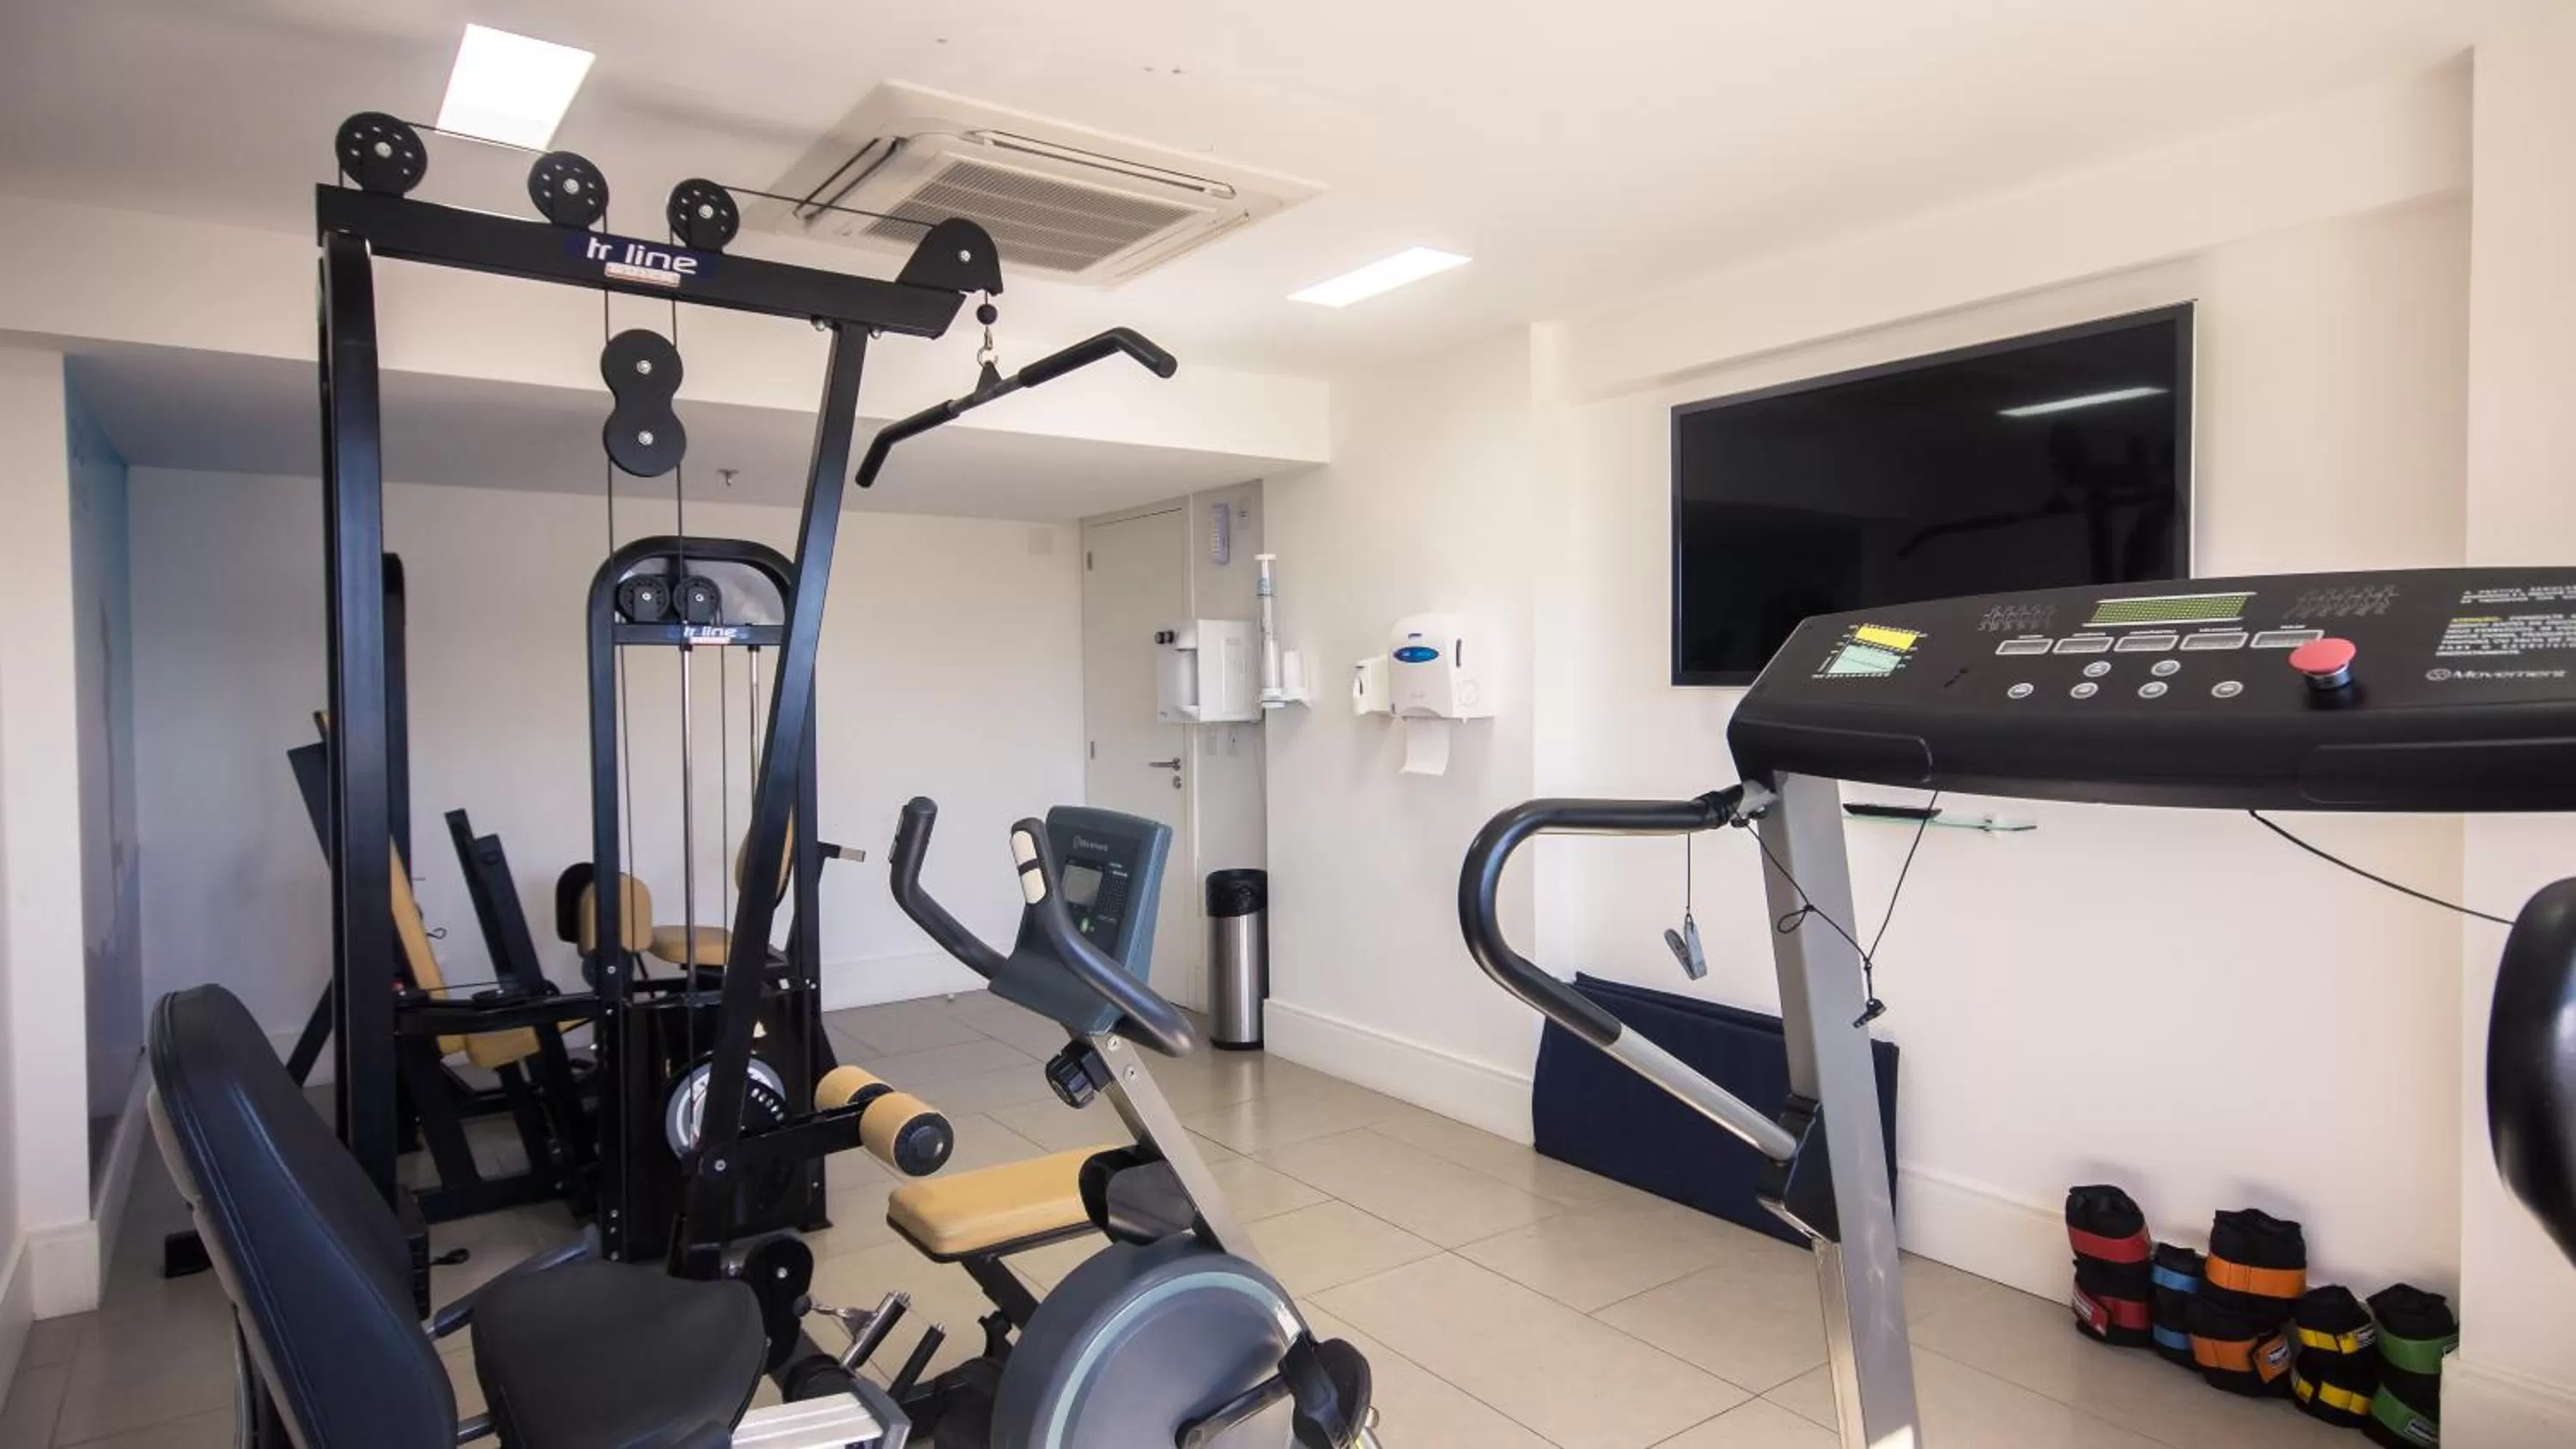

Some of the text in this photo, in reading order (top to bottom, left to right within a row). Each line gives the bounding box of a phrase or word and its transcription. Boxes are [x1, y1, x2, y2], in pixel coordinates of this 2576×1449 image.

[624, 243, 698, 276] line
[702, 626, 737, 638] line
[2452, 670, 2566, 680] Movement
